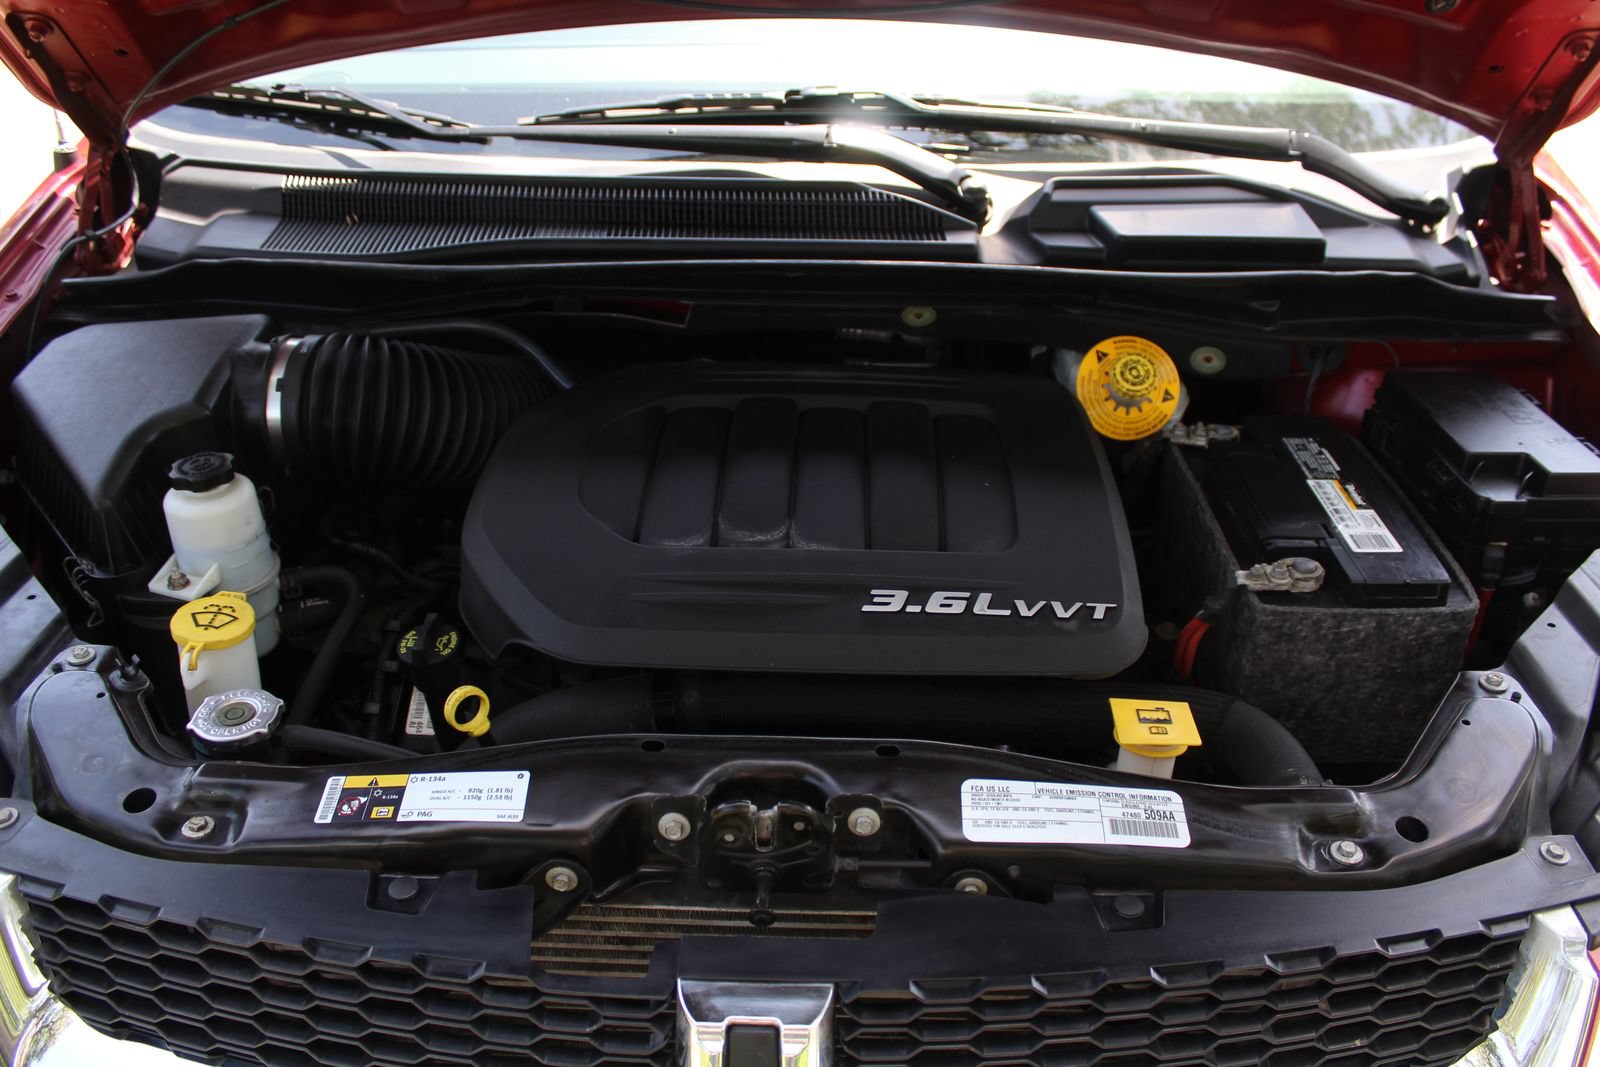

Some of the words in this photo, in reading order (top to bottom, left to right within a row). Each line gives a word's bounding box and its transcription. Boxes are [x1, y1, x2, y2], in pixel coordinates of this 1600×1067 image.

[1065, 789, 1096, 797] EMISSION
[1098, 791, 1127, 799] CONTROL
[1128, 793, 1172, 802] INFORMATION
[1143, 809, 1176, 822] 509AA
